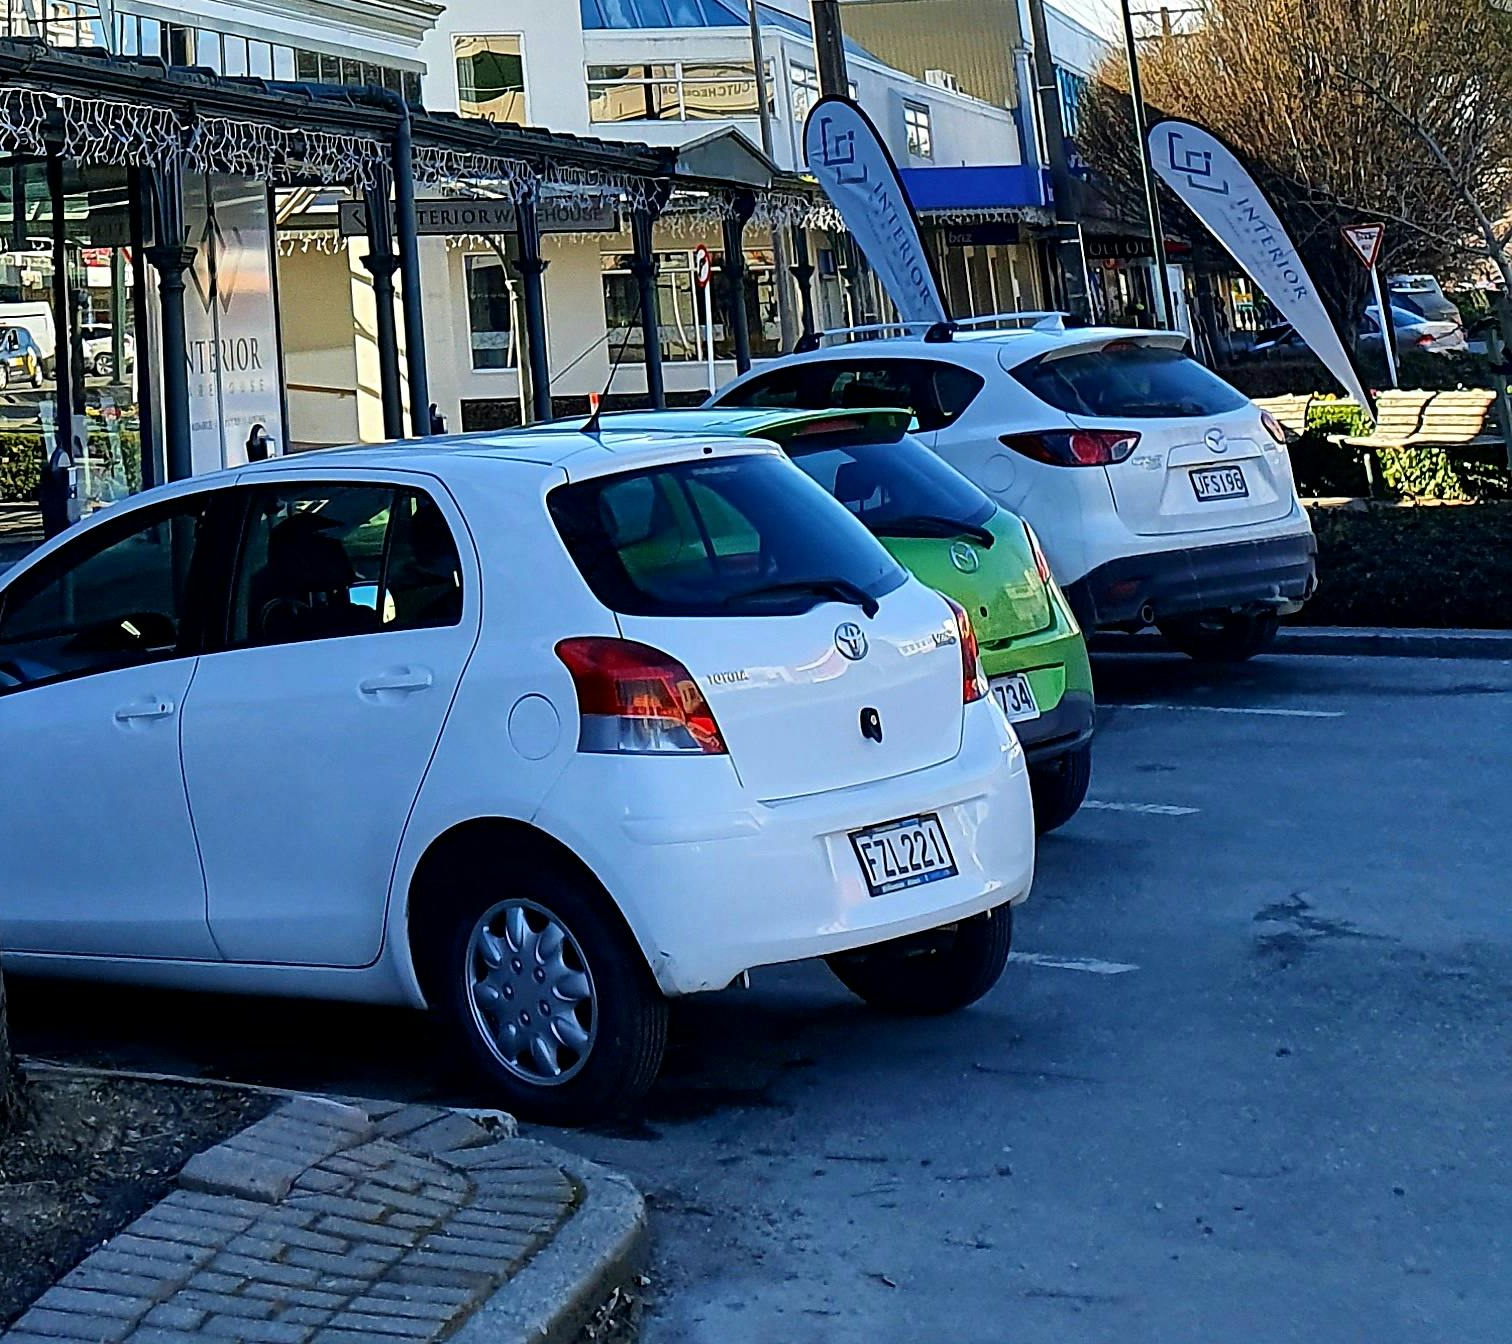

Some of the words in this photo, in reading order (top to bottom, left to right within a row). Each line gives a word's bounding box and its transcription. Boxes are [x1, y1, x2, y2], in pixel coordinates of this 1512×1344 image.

[415, 208, 491, 226] TERIOR
[494, 203, 604, 223] WEHOUSE
[872, 181, 931, 305] INTERIOR
[1237, 197, 1308, 300] INTERIOR
[186, 337, 263, 374] NTERIOR
[1196, 472, 1244, 495] JFS196
[994, 681, 1033, 715] 734
[860, 827, 945, 881] FZL221
